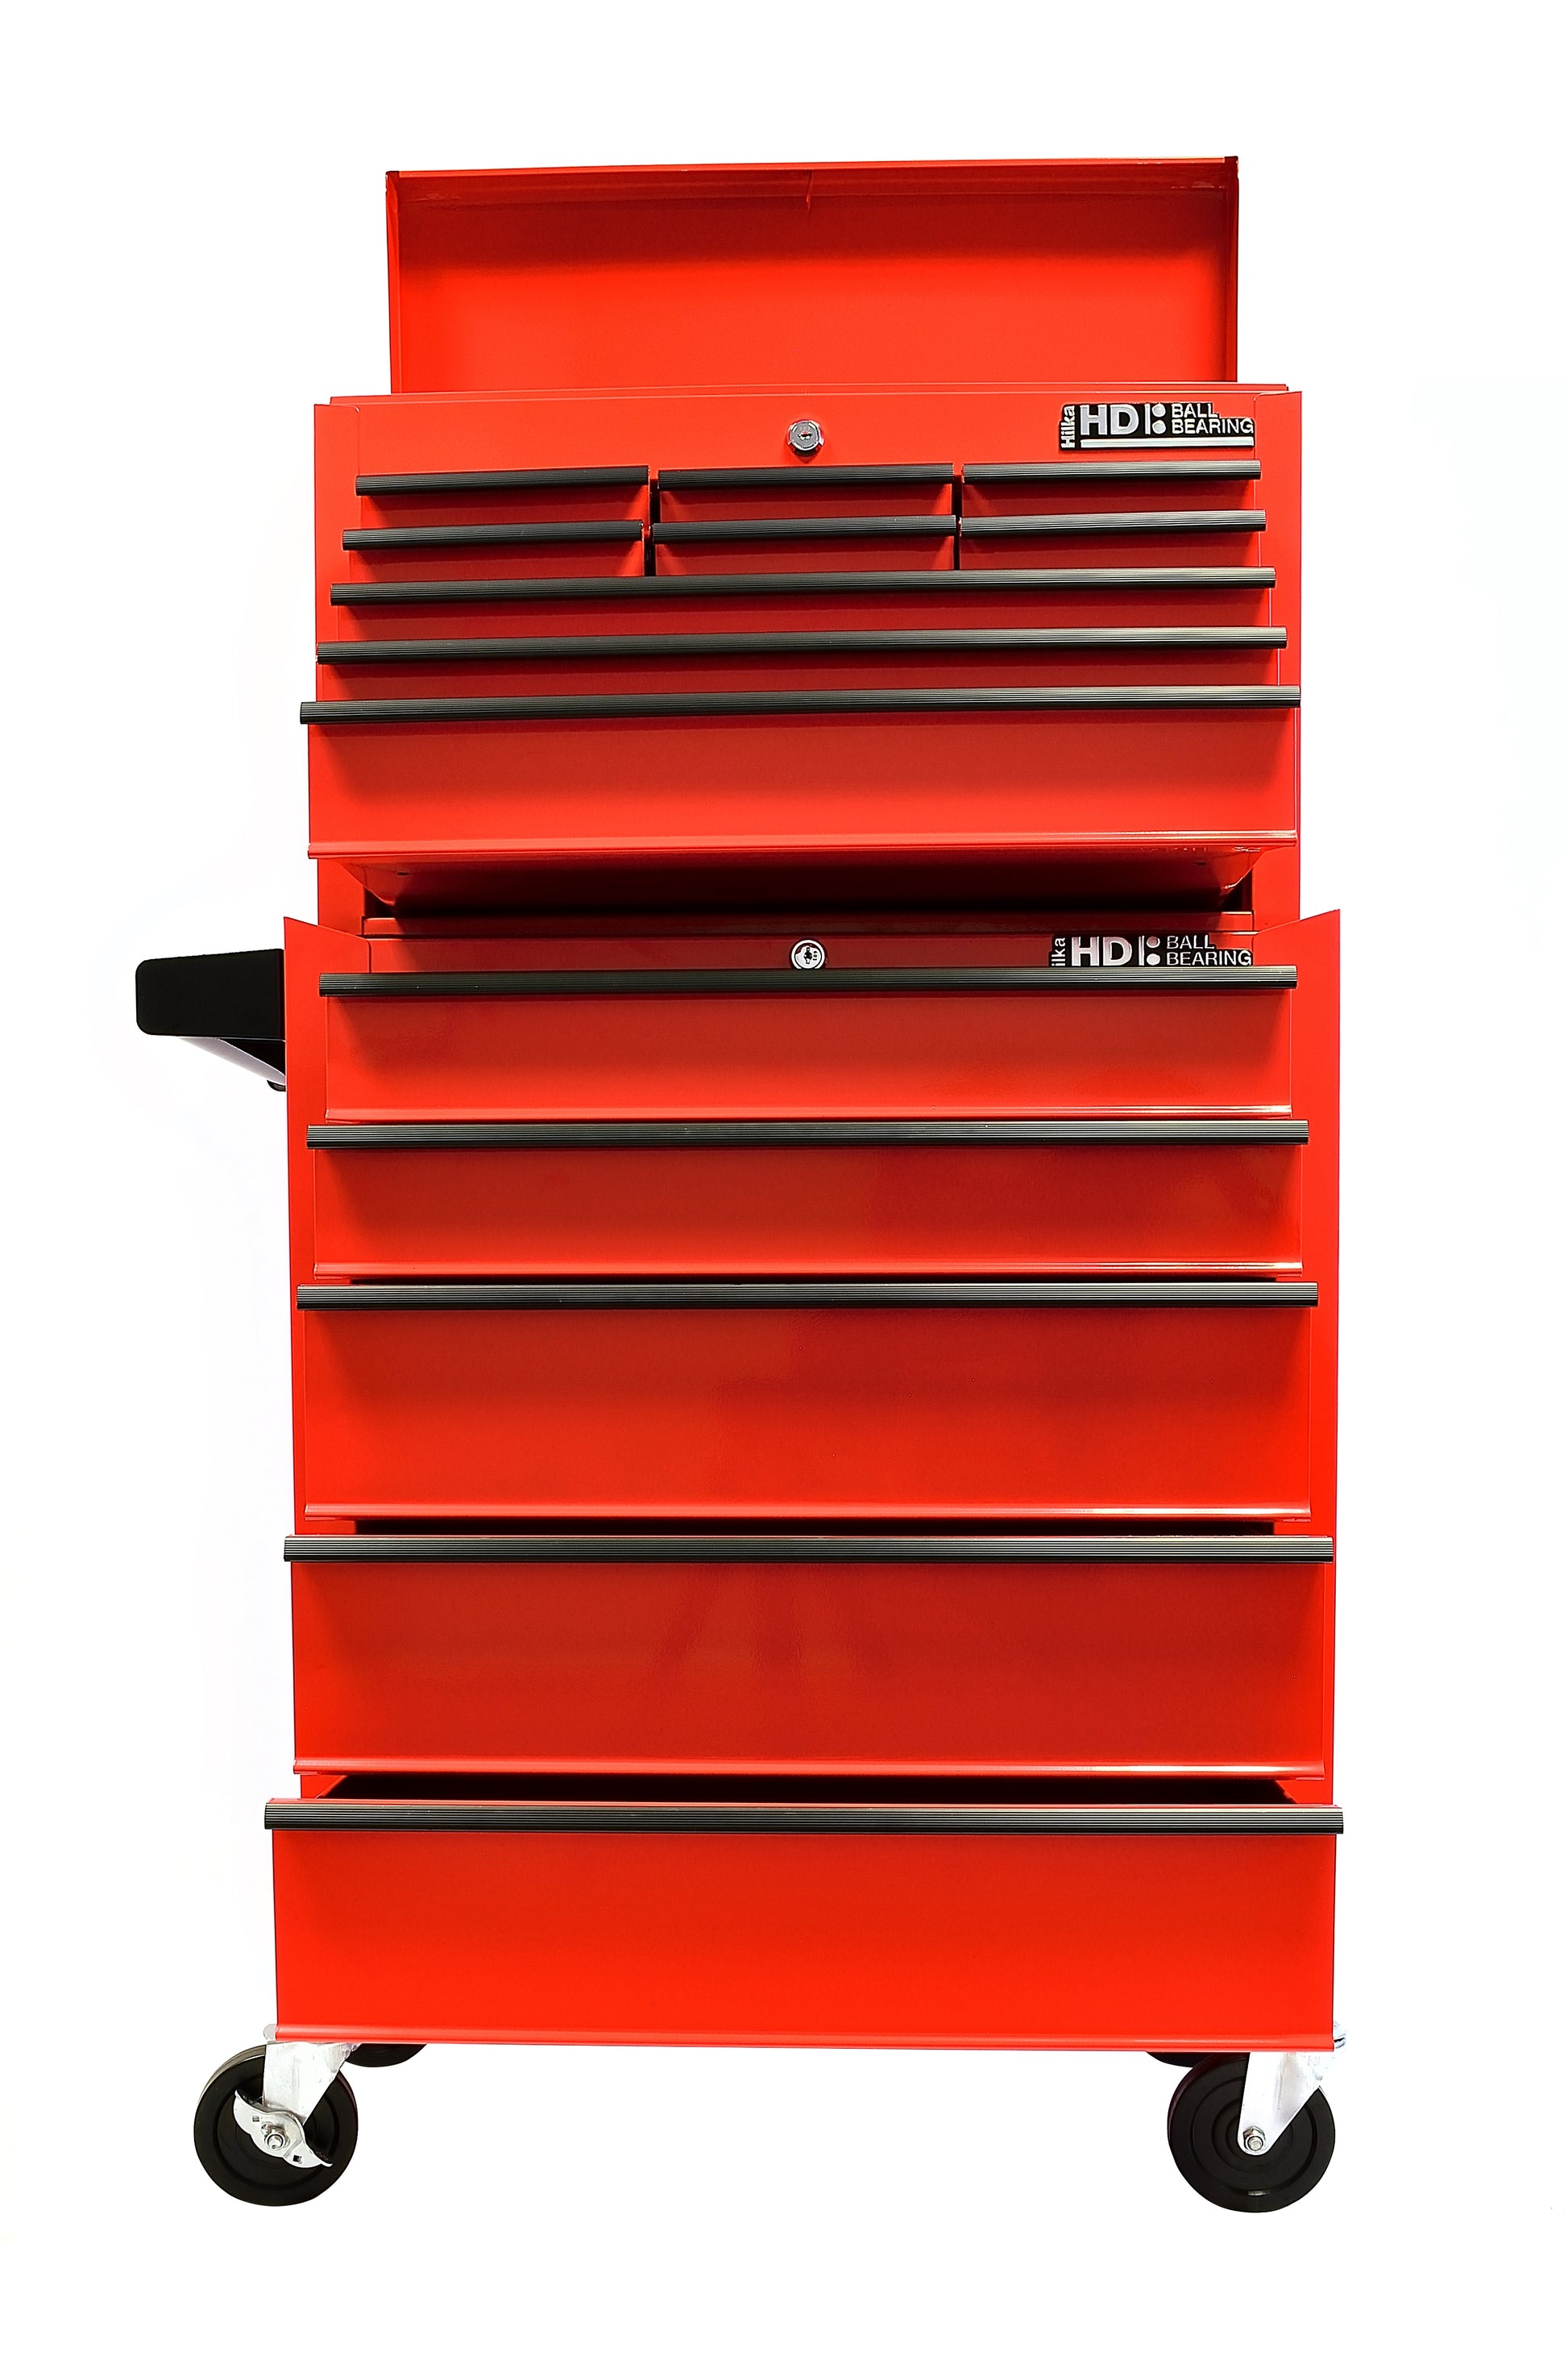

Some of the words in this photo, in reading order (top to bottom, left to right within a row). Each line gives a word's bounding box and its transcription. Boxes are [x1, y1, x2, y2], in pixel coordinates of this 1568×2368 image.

[1080, 404, 1139, 436] HD
[1171, 403, 1218, 418] BALL
[1060, 405, 1076, 449] Hilka
[1171, 418, 1254, 434] BEARING
[1051, 937, 1066, 966] ilka
[1071, 936, 1133, 966] HD
[1166, 935, 1215, 949] BALL
[1166, 949, 1252, 966] BEARING
